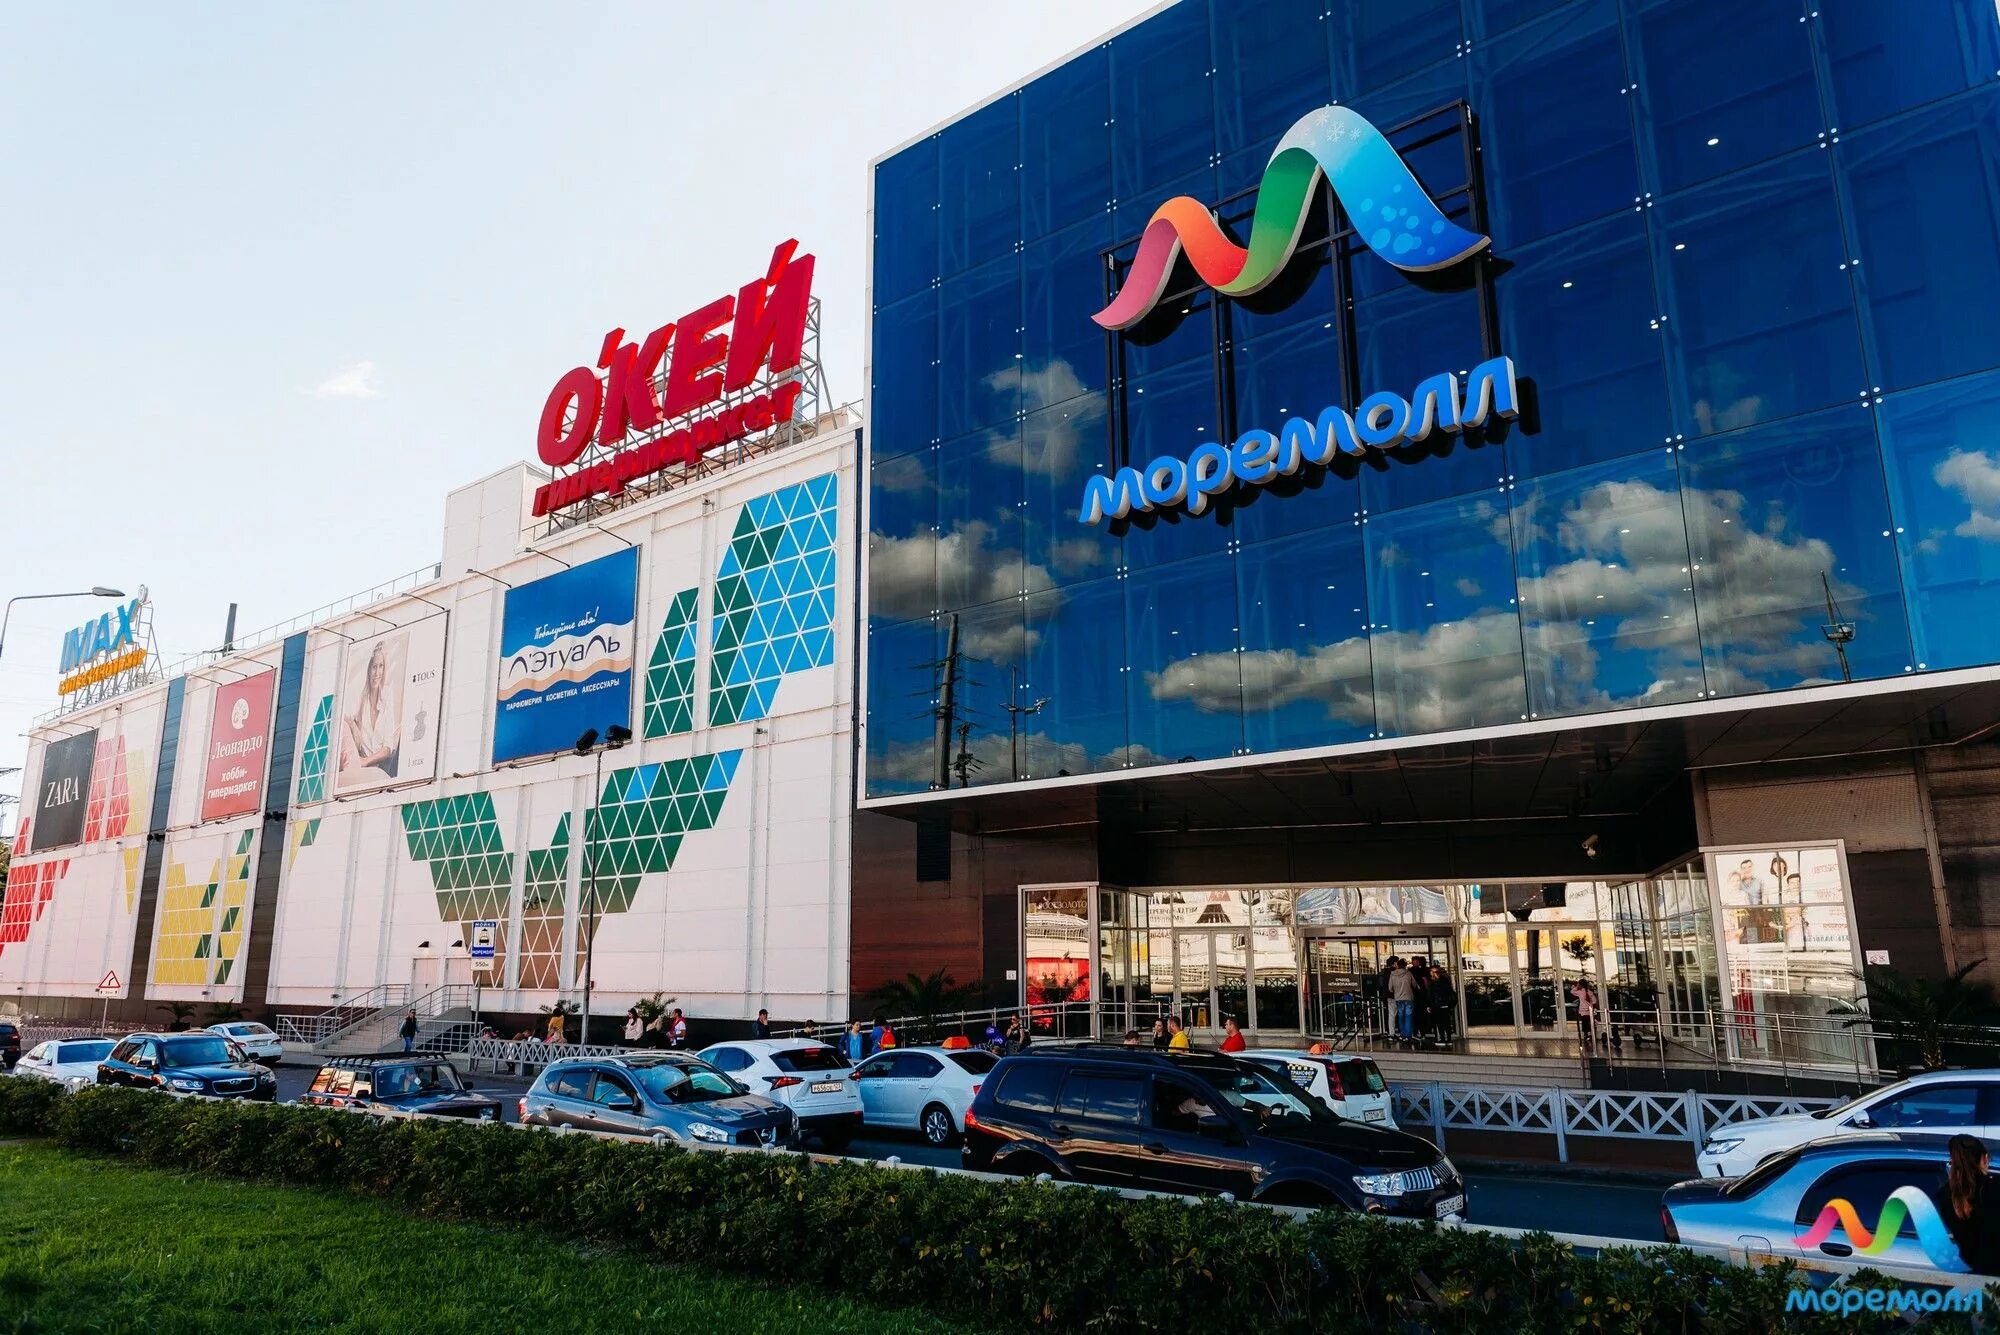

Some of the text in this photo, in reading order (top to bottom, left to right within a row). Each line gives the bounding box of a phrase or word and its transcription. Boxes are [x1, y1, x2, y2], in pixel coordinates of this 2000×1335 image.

[532, 381, 803, 518] гипермаркет
[1079, 356, 1518, 526] моремолл
[59, 598, 138, 675] IMAX
[533, 606, 600, 640] Побалуйте себя!
[417, 669, 436, 682] TOUS
[505, 678, 620, 711] ПАРФЮМЕРИЯ КОСМЕТИКА АКСЕССУАРЫ
[212, 735, 263, 760] Леонардо
[207, 780, 258, 799] гипермаркет
[221, 765, 248, 782] хобби-
[45, 776, 80, 808] ZARA
